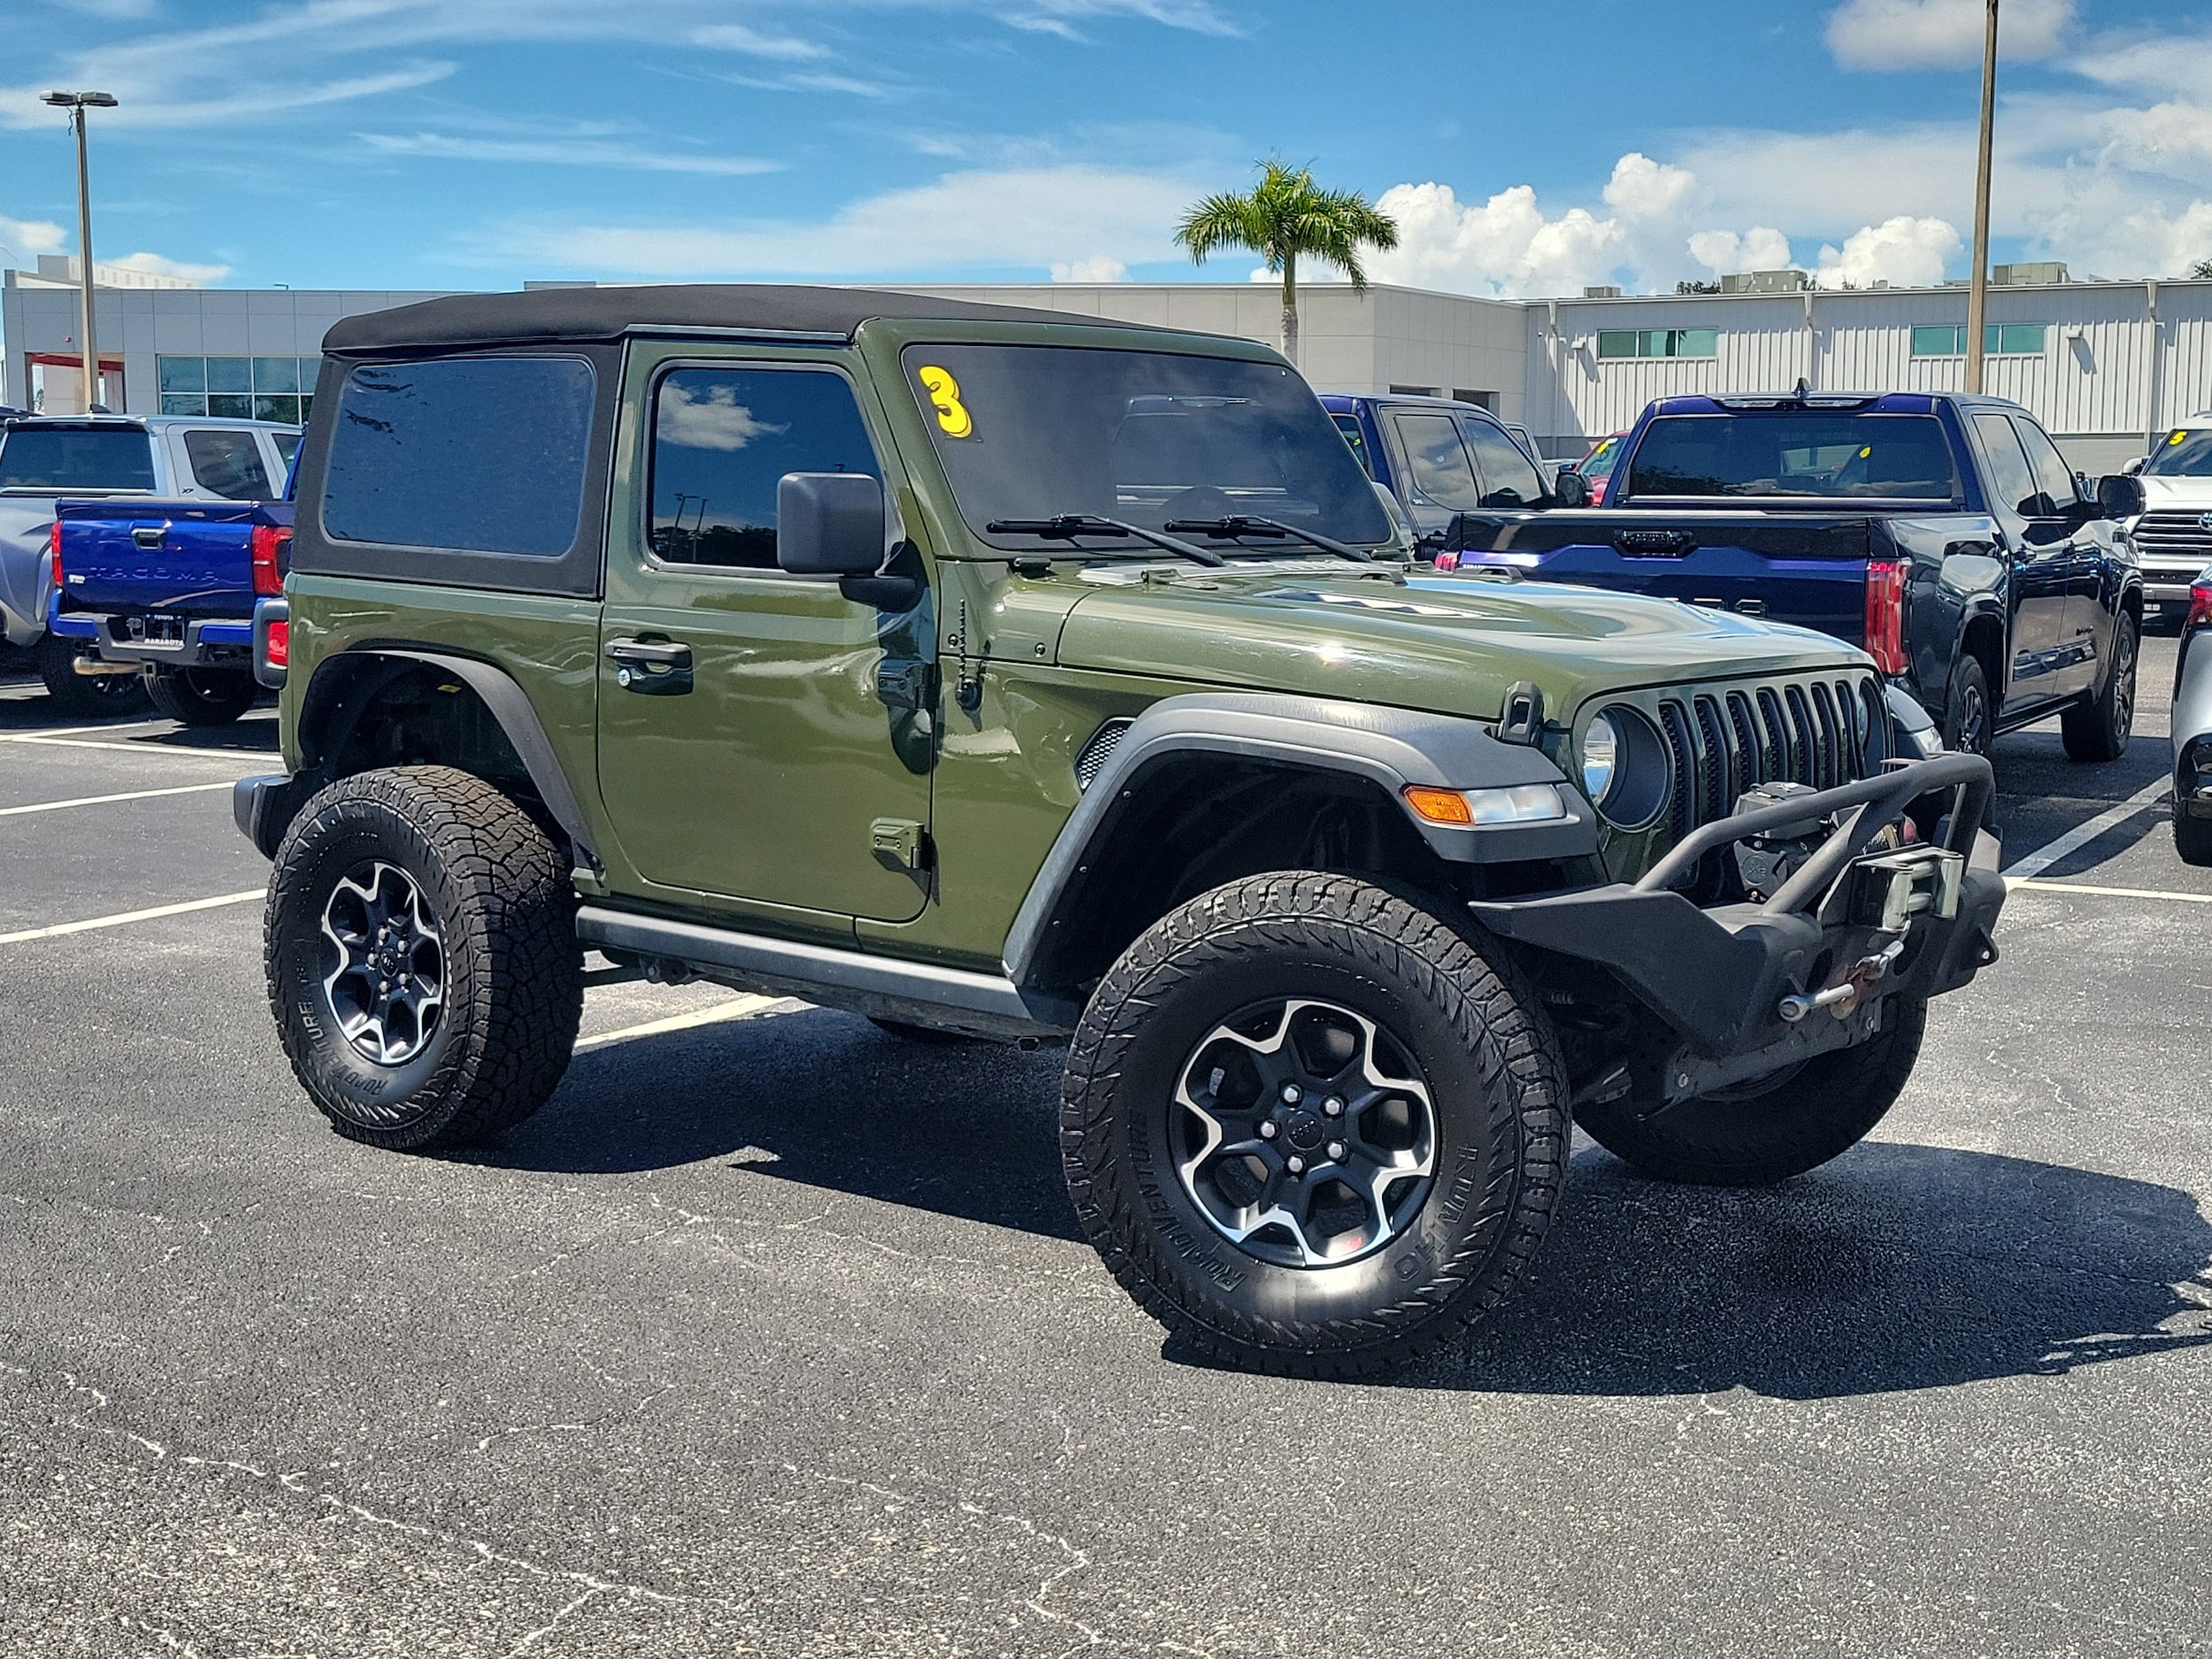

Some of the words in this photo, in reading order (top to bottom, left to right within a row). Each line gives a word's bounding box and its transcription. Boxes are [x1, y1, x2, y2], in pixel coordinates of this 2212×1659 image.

[918, 364, 973, 439] 3
[89, 566, 219, 581] TACOMA
[1394, 1146, 1479, 1282] KUMHO
